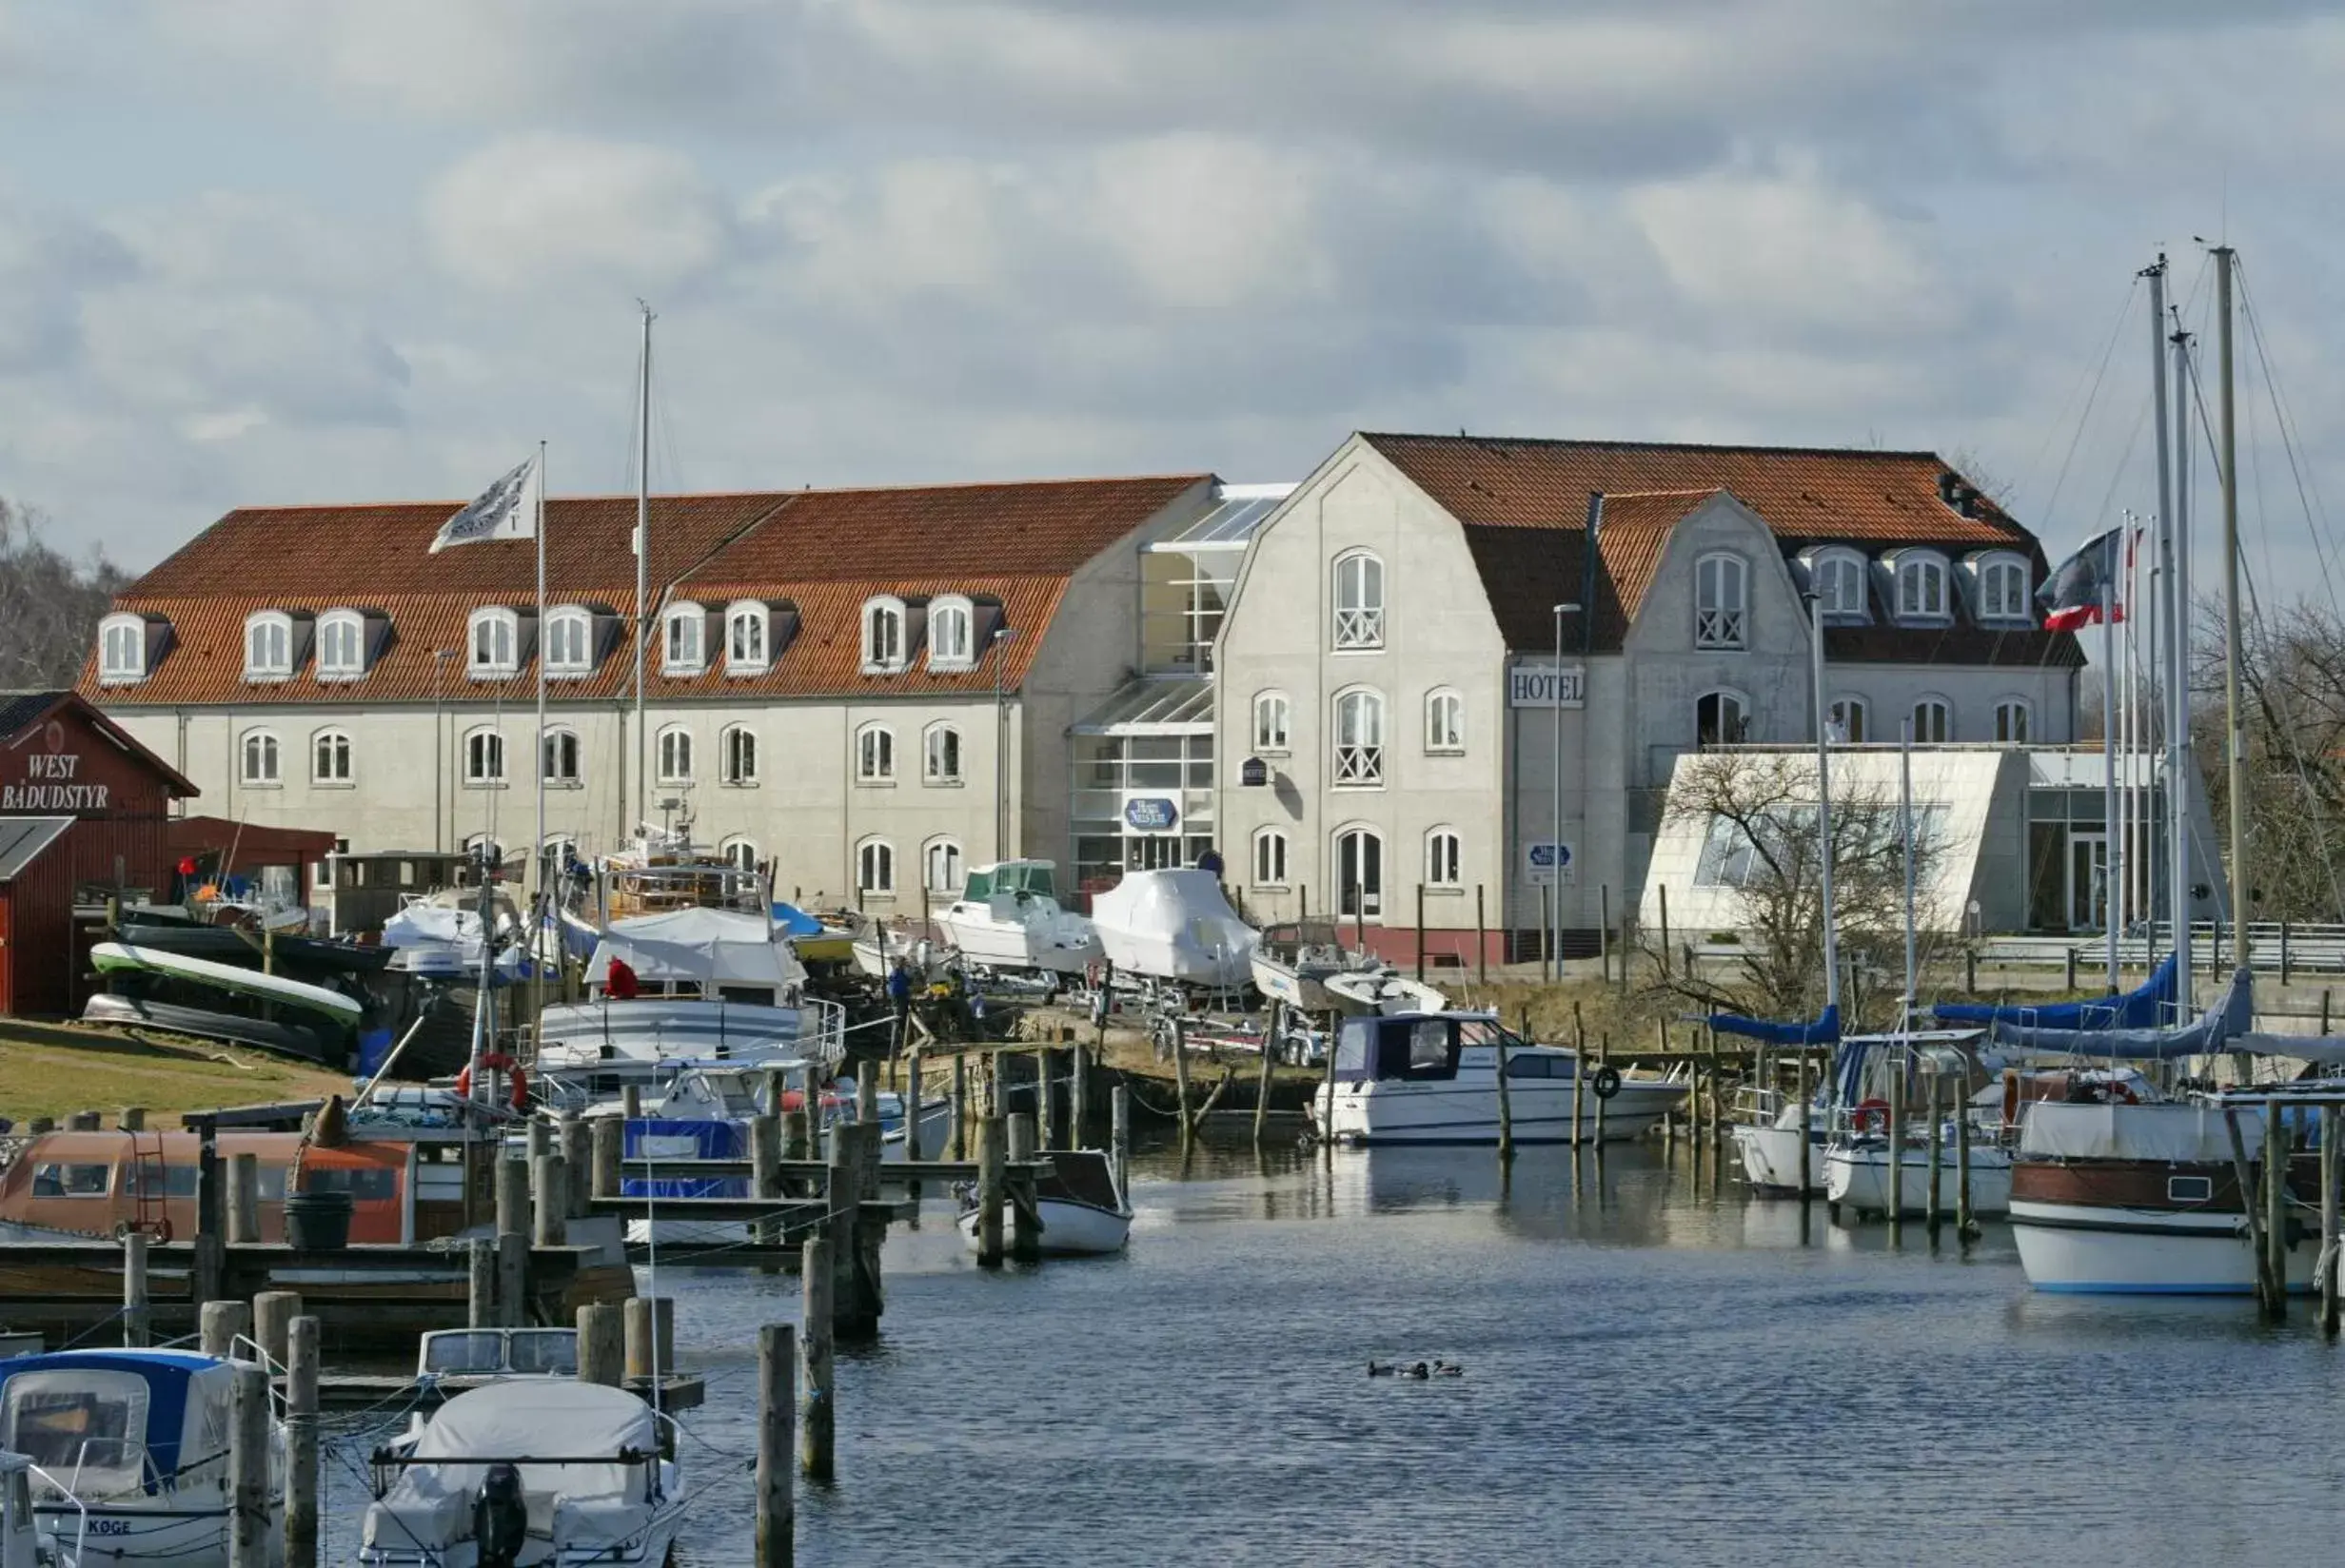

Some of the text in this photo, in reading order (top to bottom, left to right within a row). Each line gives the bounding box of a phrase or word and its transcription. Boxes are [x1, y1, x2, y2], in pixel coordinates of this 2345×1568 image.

[1513, 674, 1584, 700] HOTEL
[28, 755, 79, 778] WEST
[2, 778, 108, 810] BÅDUDSTYR
[89, 1520, 131, 1534] KØGE
